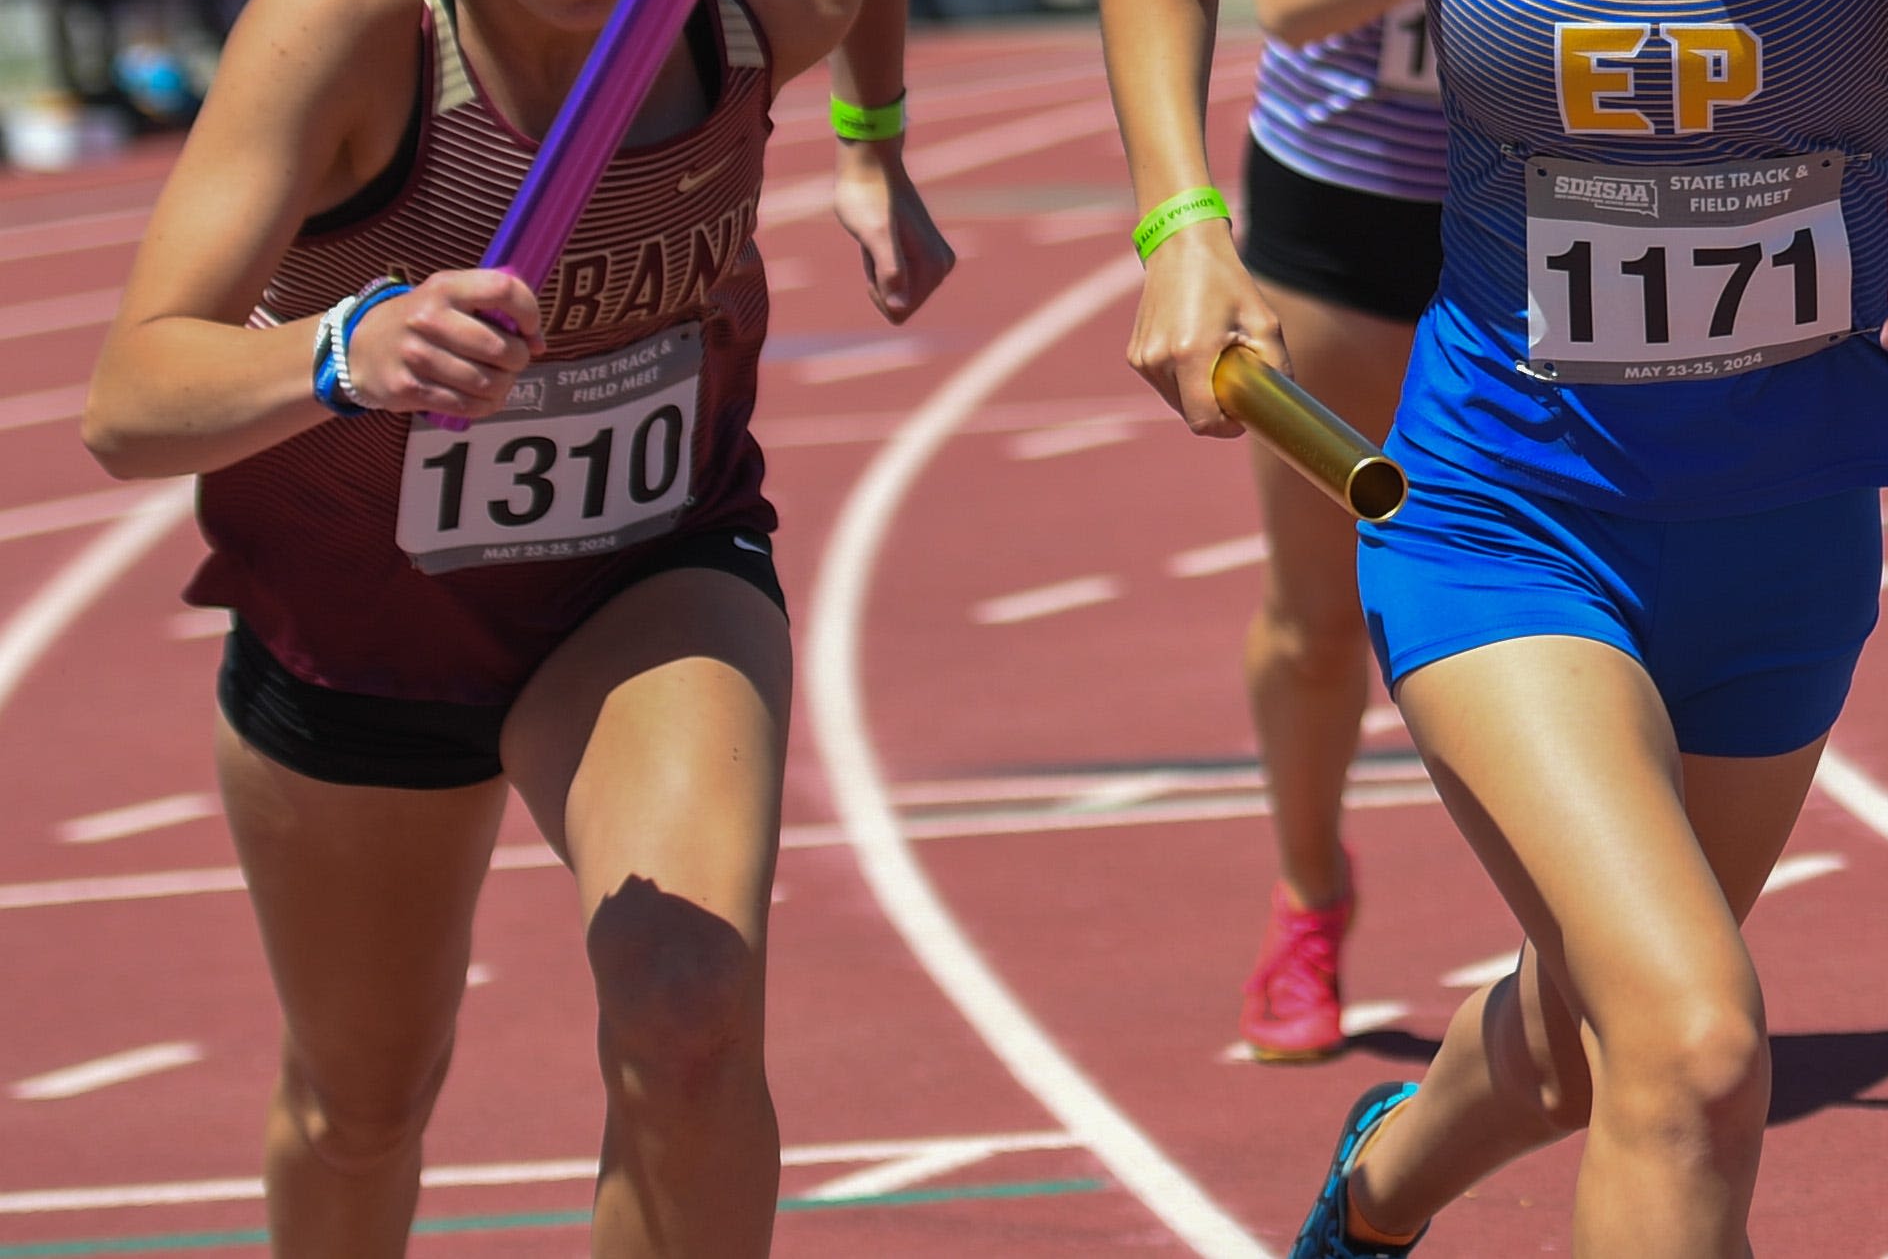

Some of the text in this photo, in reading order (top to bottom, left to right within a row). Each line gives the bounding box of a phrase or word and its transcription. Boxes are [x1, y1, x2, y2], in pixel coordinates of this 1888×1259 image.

[1554, 22, 1763, 134] EP
[1554, 175, 1650, 203] SDHSAA
[1670, 164, 1809, 191] STATE TRACK &
[1689, 188, 1792, 213] FIELD MEET
[1546, 227, 1818, 344] 1171
[557, 339, 672, 385] STATE TRACK &
[1624, 352, 1763, 379] MAY 23-25, 2024
[572, 366, 660, 403] FIELD MEET
[421, 403, 684, 533] 1310
[482, 546, 521, 560] MAY
